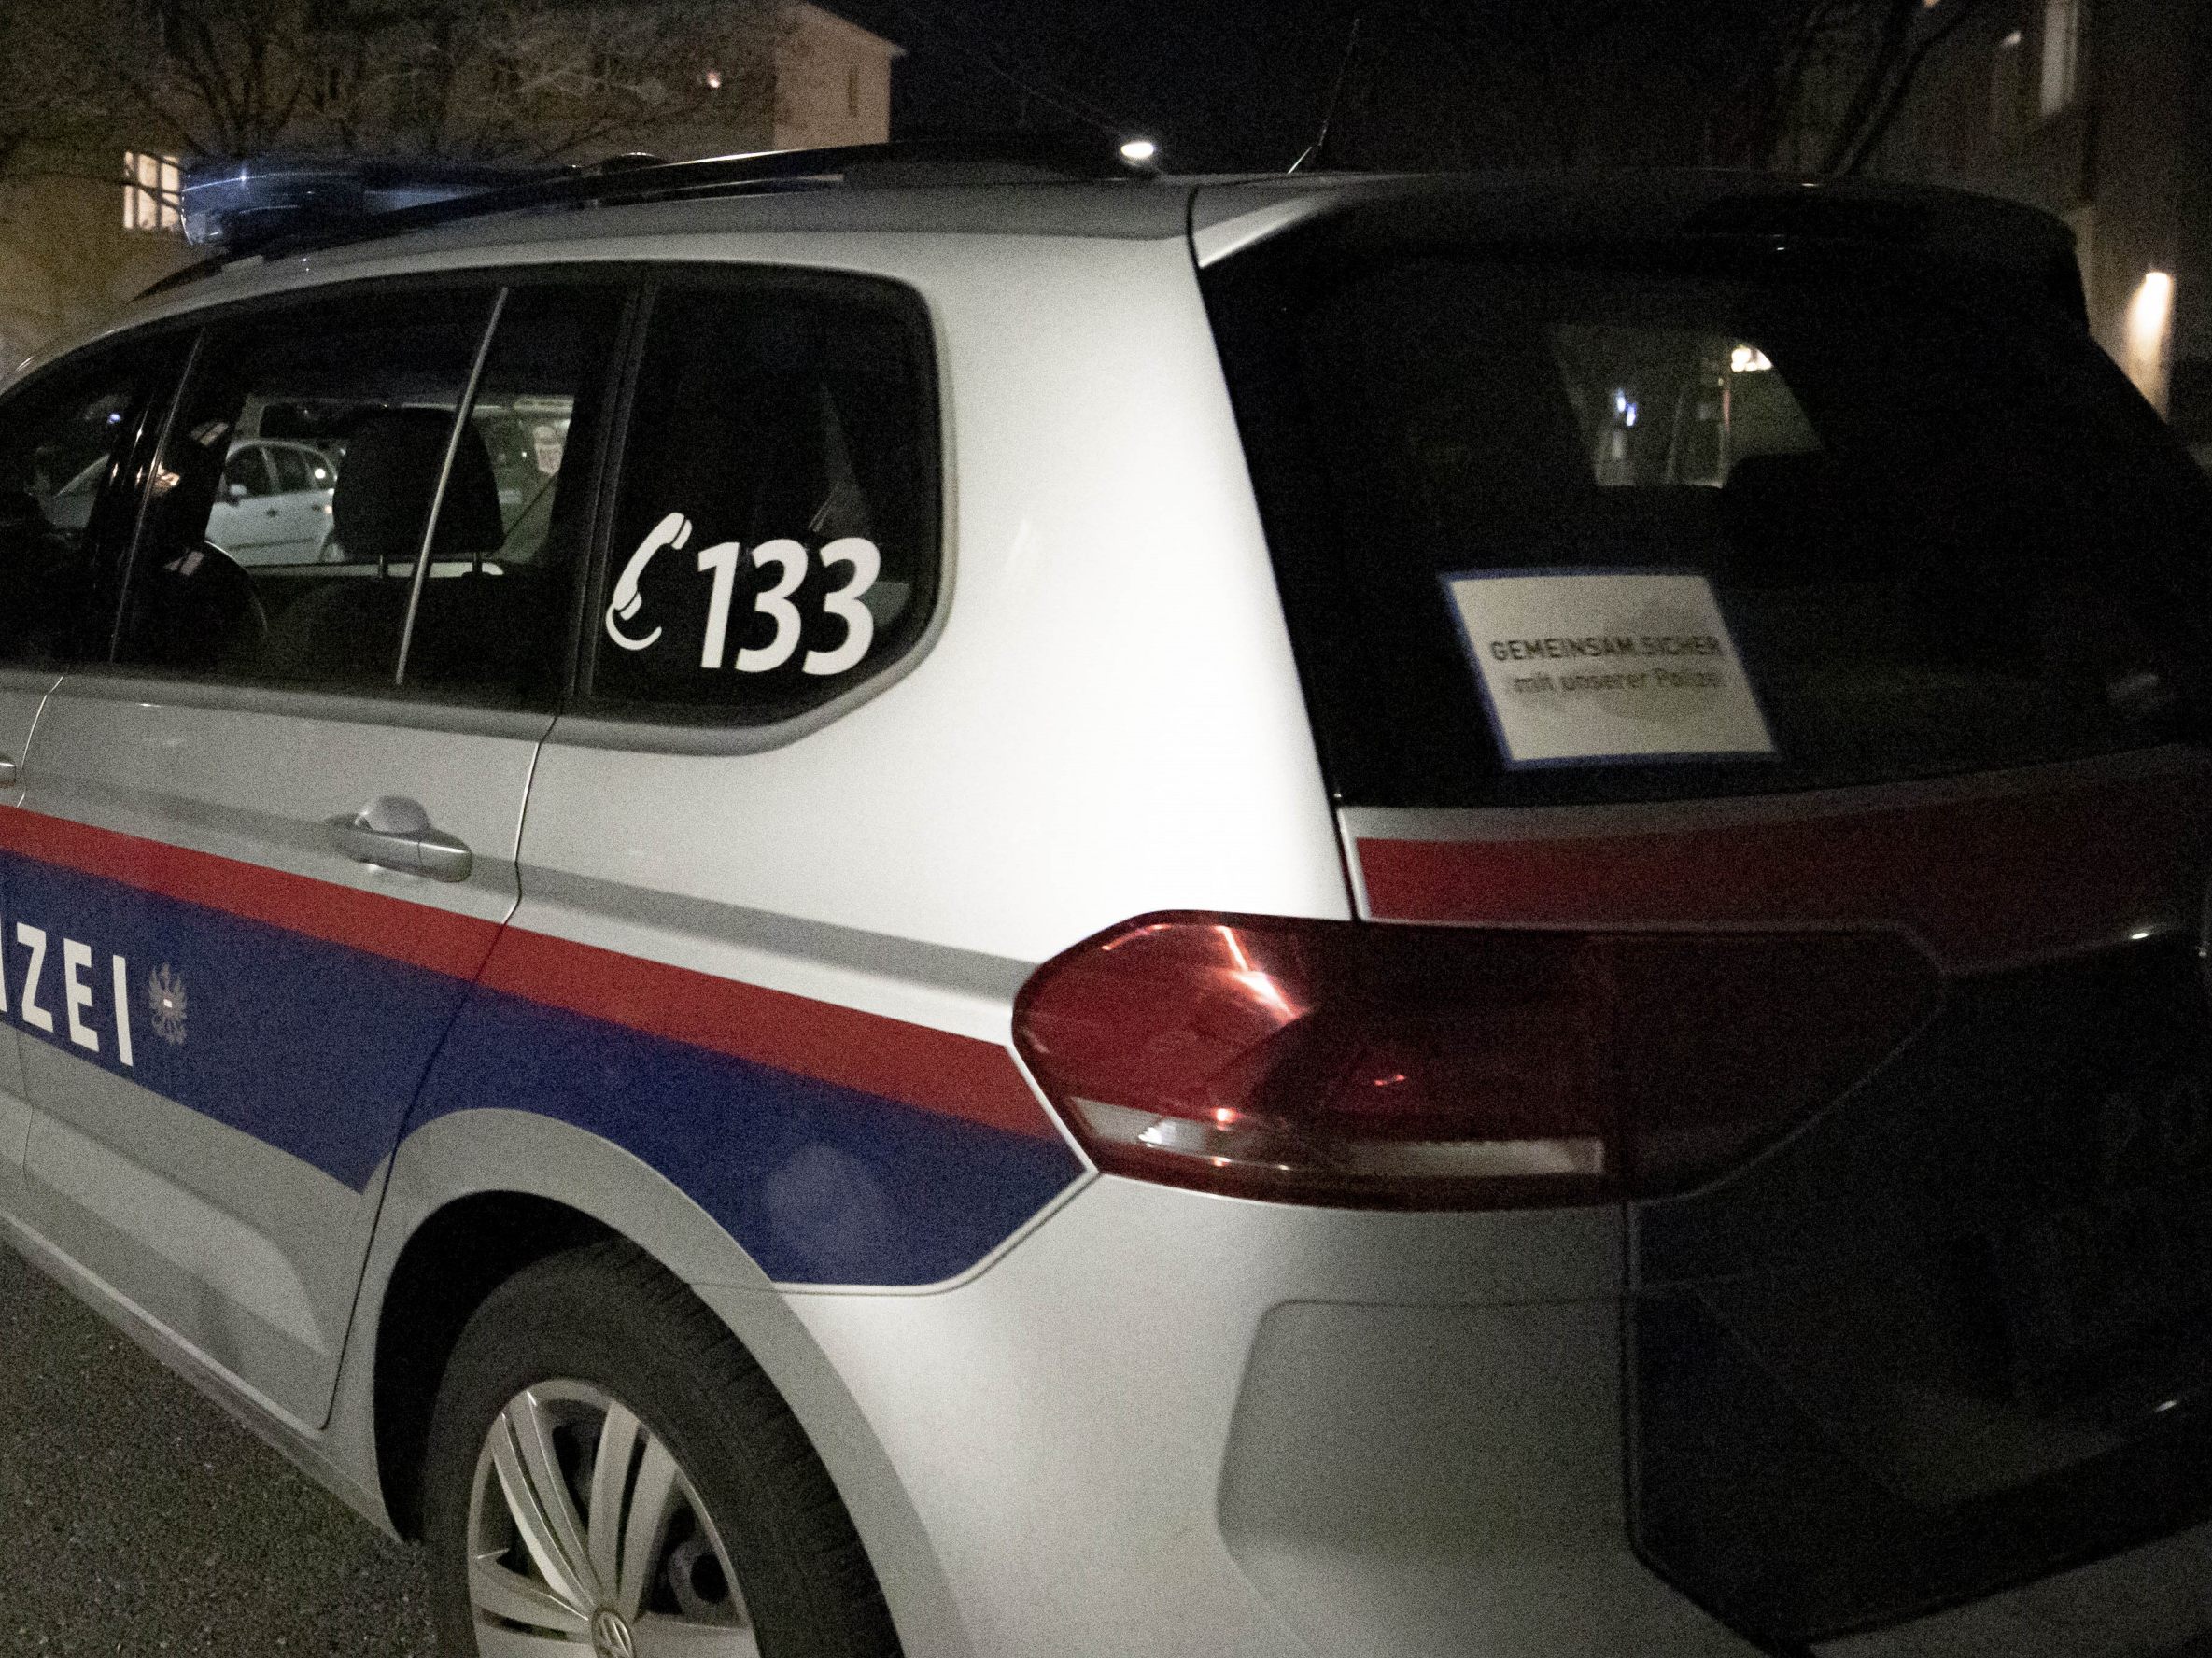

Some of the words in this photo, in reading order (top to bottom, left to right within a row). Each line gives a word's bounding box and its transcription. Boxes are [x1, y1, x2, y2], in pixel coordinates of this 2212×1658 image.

[697, 537, 881, 676] 133
[1515, 671, 1557, 692] mit
[1560, 673, 1647, 692] unserer
